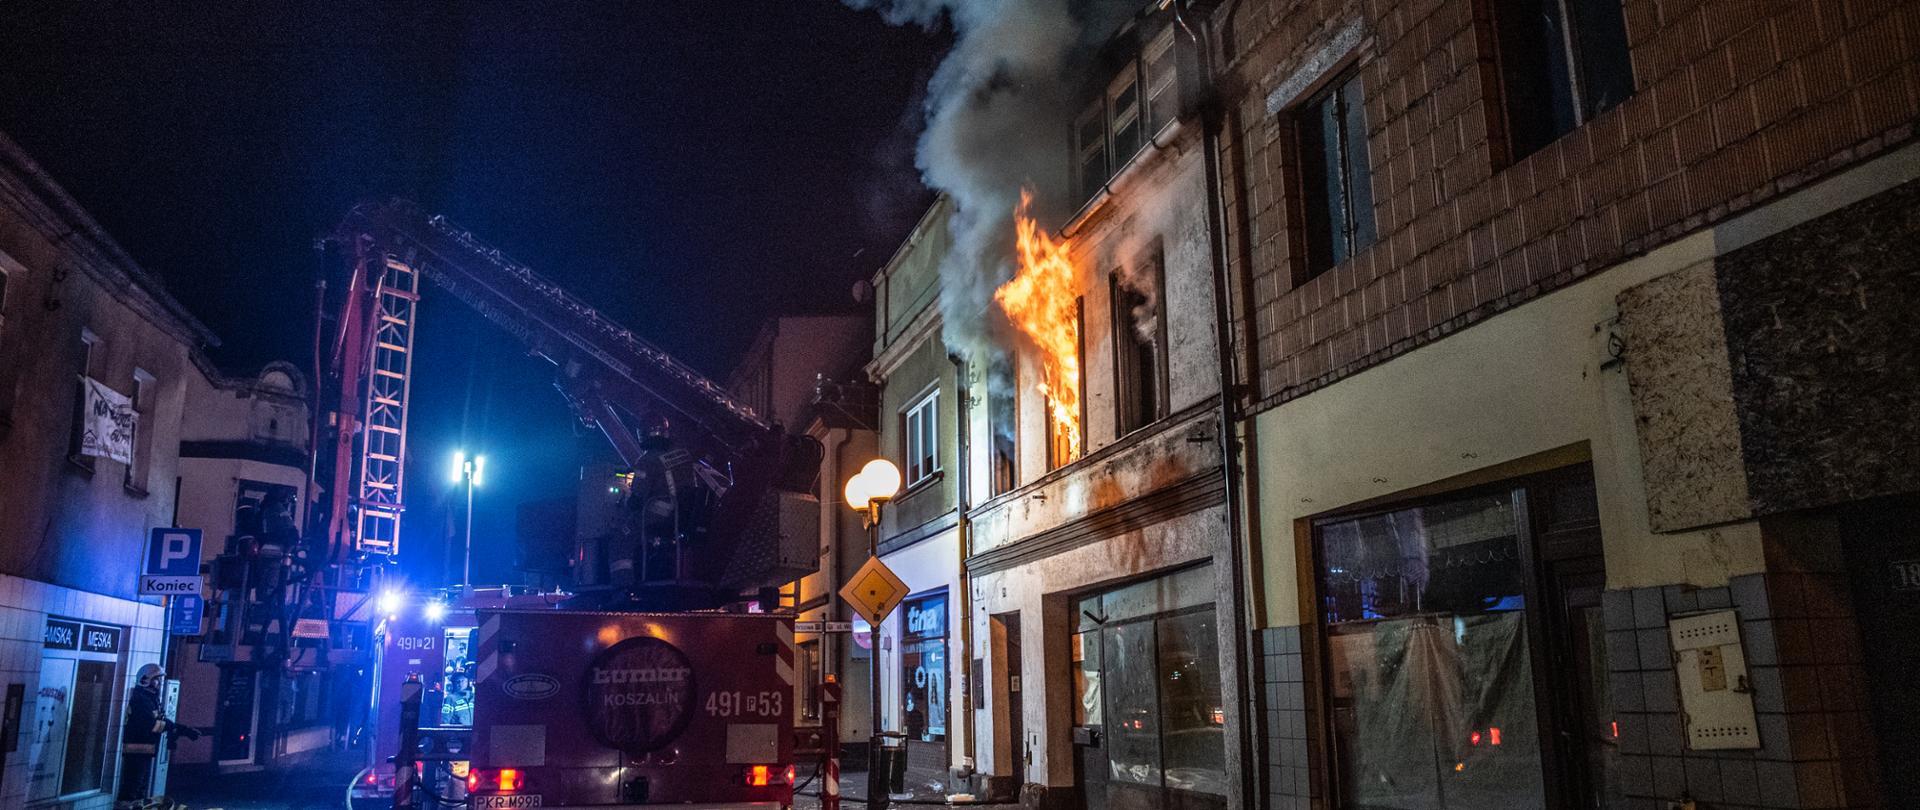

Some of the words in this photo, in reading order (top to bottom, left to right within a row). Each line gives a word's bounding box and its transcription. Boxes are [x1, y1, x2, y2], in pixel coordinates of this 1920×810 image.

[160, 533, 191, 569] P
[146, 579, 195, 592] Koniec
[907, 606, 937, 633] tina
[88, 631, 112, 651] MĘSKA
[397, 636, 416, 650] 491
[423, 636, 435, 650] 21
[603, 691, 679, 706] KOSZALIN
[705, 691, 741, 717] 491
[758, 691, 782, 717] 53
[476, 795, 505, 809] PKR
[509, 795, 540, 809] M998
